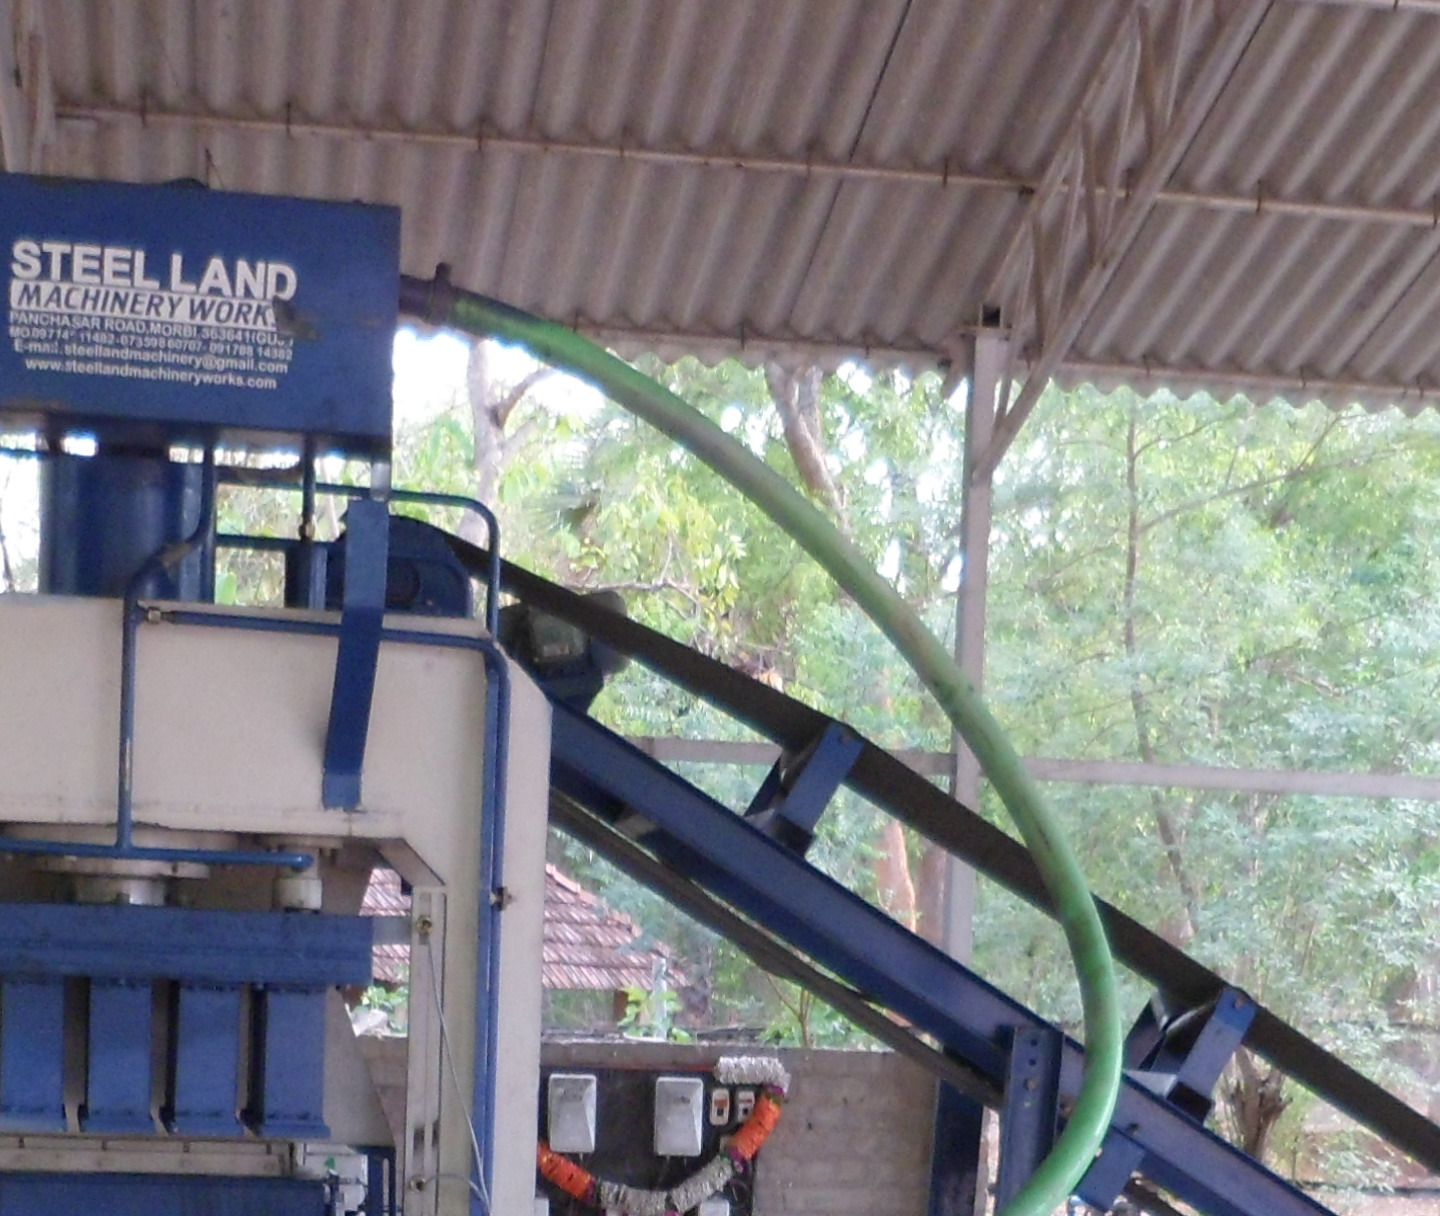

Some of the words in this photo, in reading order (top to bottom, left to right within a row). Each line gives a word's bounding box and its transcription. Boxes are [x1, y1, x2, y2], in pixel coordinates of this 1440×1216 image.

[11, 240, 160, 290] STEEL
[171, 253, 298, 301] LAND
[10, 310, 100, 330] PANCHASAR
[17, 283, 182, 319] MACHINERY
[189, 297, 277, 328] WORK
[25, 358, 278, 389] www.steellandmachineryworks.com
